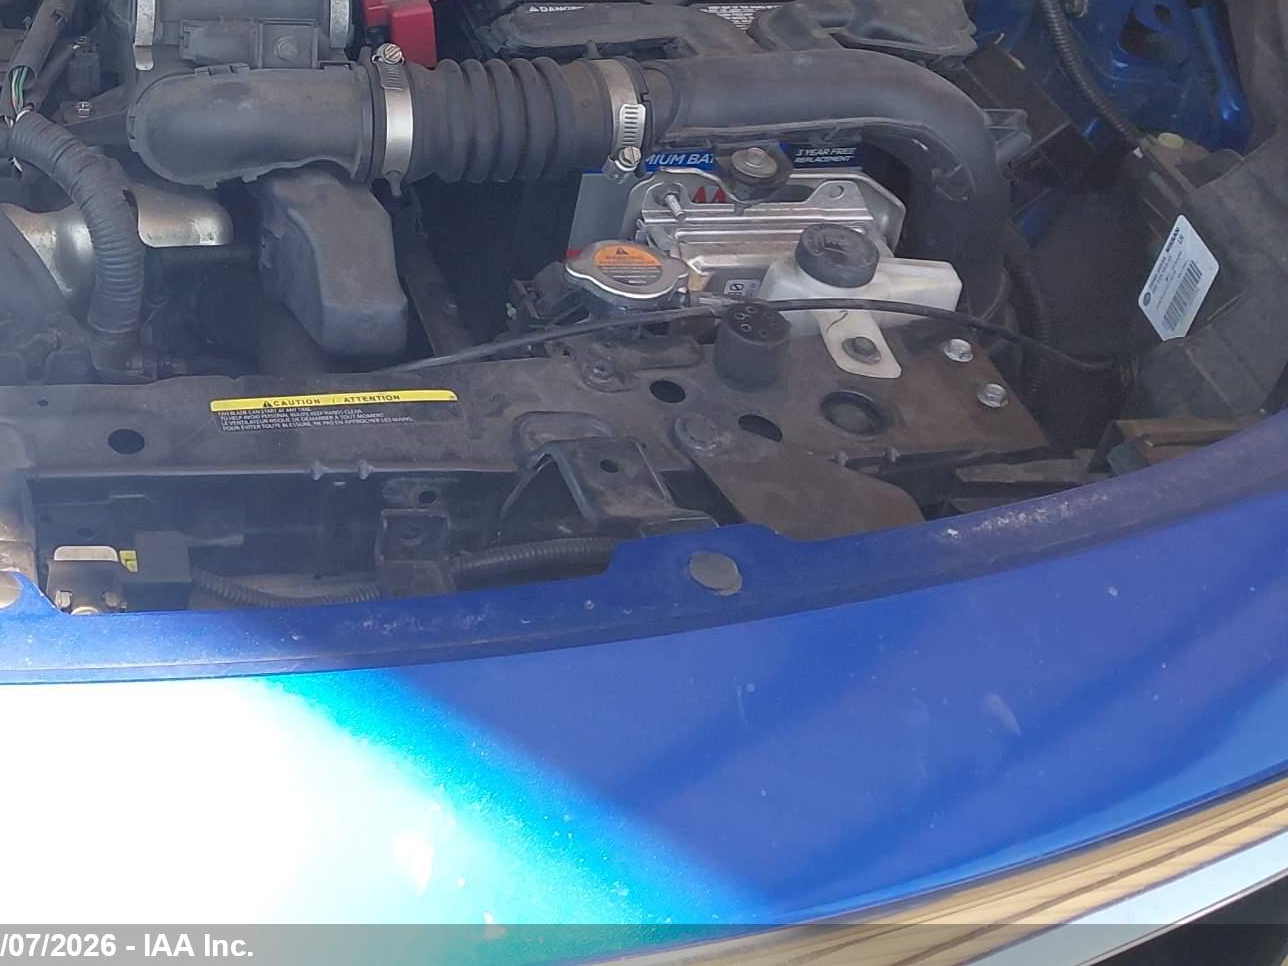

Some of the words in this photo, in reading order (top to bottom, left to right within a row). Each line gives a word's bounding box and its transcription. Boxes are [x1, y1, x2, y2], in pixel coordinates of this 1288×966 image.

[806, 148, 830, 156] YEAR
[830, 147, 857, 155] FREE
[273, 398, 321, 407] CAUTION
[344, 394, 400, 403] ATTENTION
